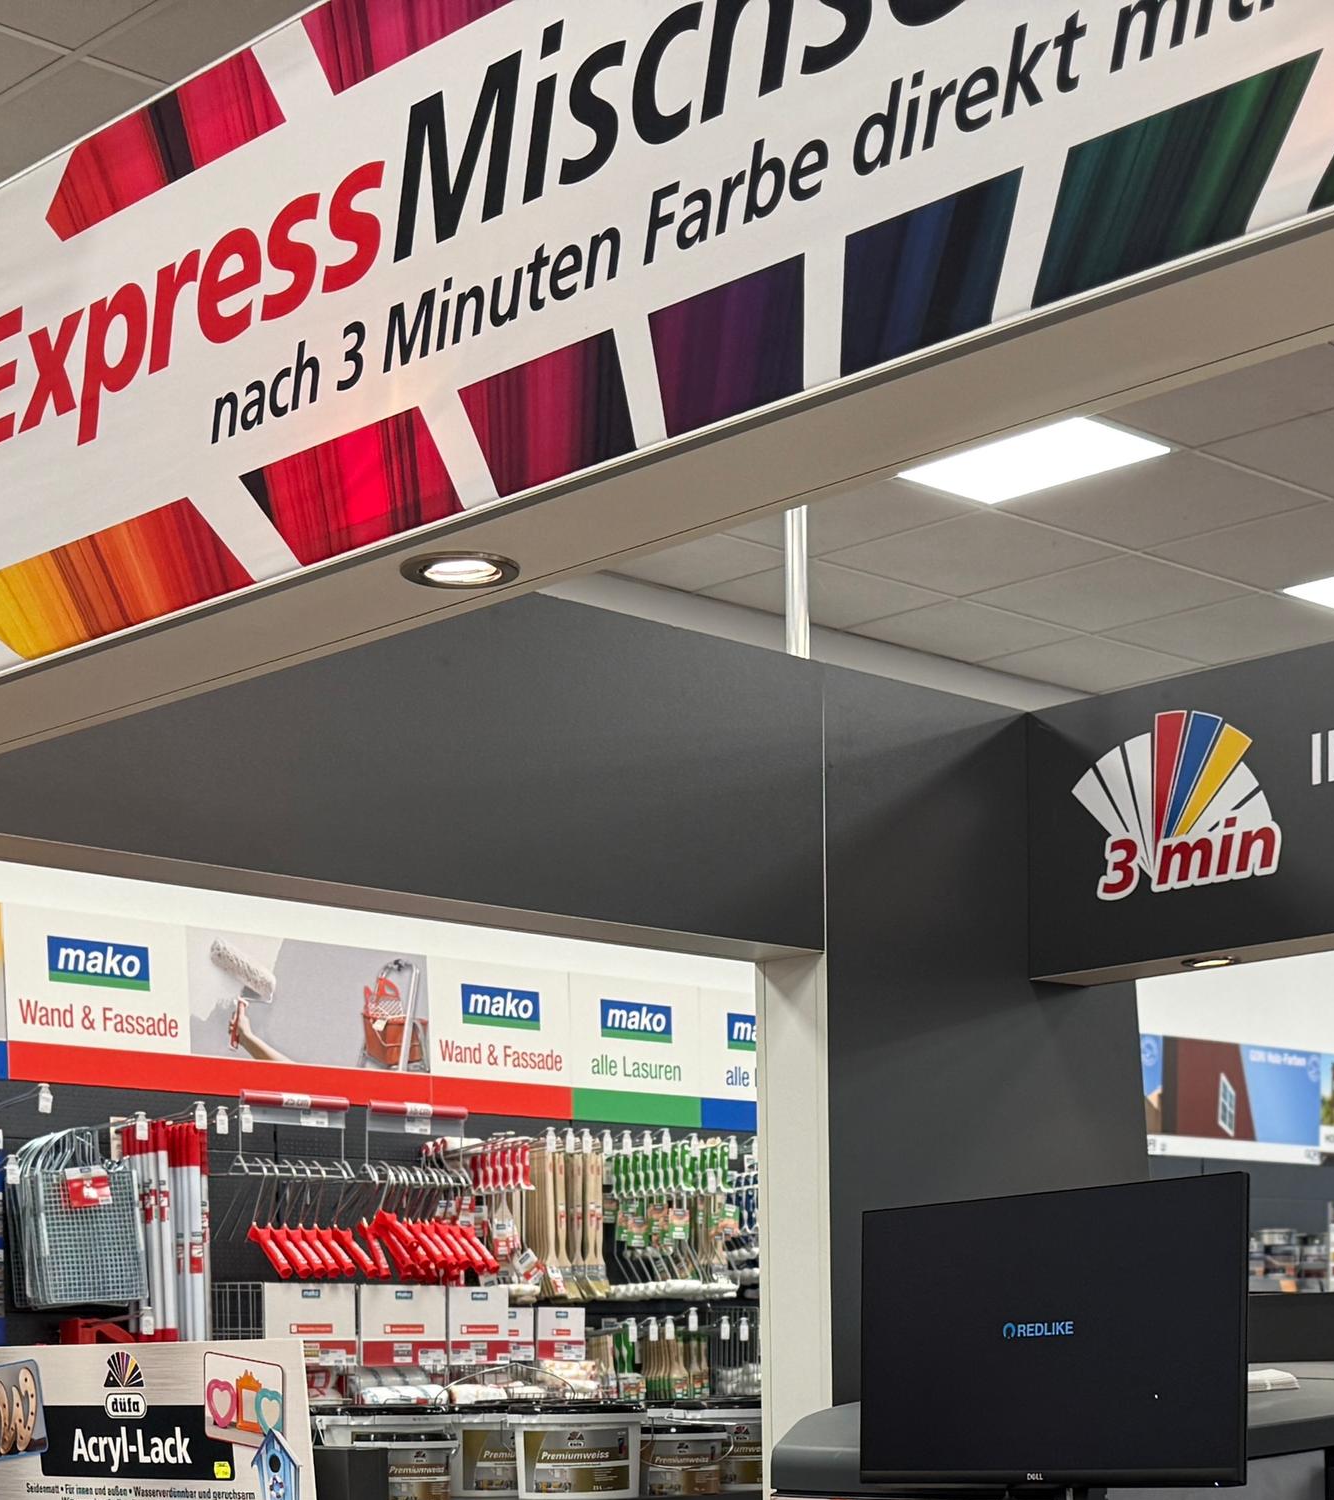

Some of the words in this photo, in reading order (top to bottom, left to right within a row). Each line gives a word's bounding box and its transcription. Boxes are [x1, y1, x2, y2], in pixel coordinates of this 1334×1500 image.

[212, 343, 320, 445] nach
[336, 322, 364, 393] 3
[382, 214, 622, 374] Minuten
[643, 138, 830, 266] Farbe
[853, 9, 1088, 176] direkt
[1109, 0, 1269, 73] mit
[1102, 838, 1139, 895] 3
[1156, 816, 1278, 888] min
[55, 945, 144, 980] mako
[18, 1001, 72, 1031] Wand
[79, 1006, 95, 1033] &
[100, 1006, 179, 1040] Fassade
[467, 991, 536, 1022] mako
[606, 1004, 668, 1035] mako
[439, 1039, 480, 1066] Wand
[485, 1042, 497, 1067] &
[501, 1043, 564, 1073] Fassade
[590, 1054, 617, 1078] alle
[622, 1057, 682, 1083] Lasuren
[725, 1064, 750, 1087] alle
[1017, 1320, 1074, 1338] REDLIKE
[111, 1396, 140, 1414] düfa
[72, 1426, 192, 1472] Acryl-Lack
[541, 1450, 609, 1462] Premiumweiss
[26, 1482, 60, 1493] Seidenmatt
[65, 1484, 74, 1494] Für
[75, 1486, 93, 1494] innen
[95, 1486, 106, 1495] und
[107, 1486, 128, 1496] außen
[133, 1487, 196, 1498] Wasserverdünnbar
[199, 1489, 211, 1499] und
[213, 1490, 255, 1500] geruchsarm
[1026, 1472, 1044, 1481] DELL
